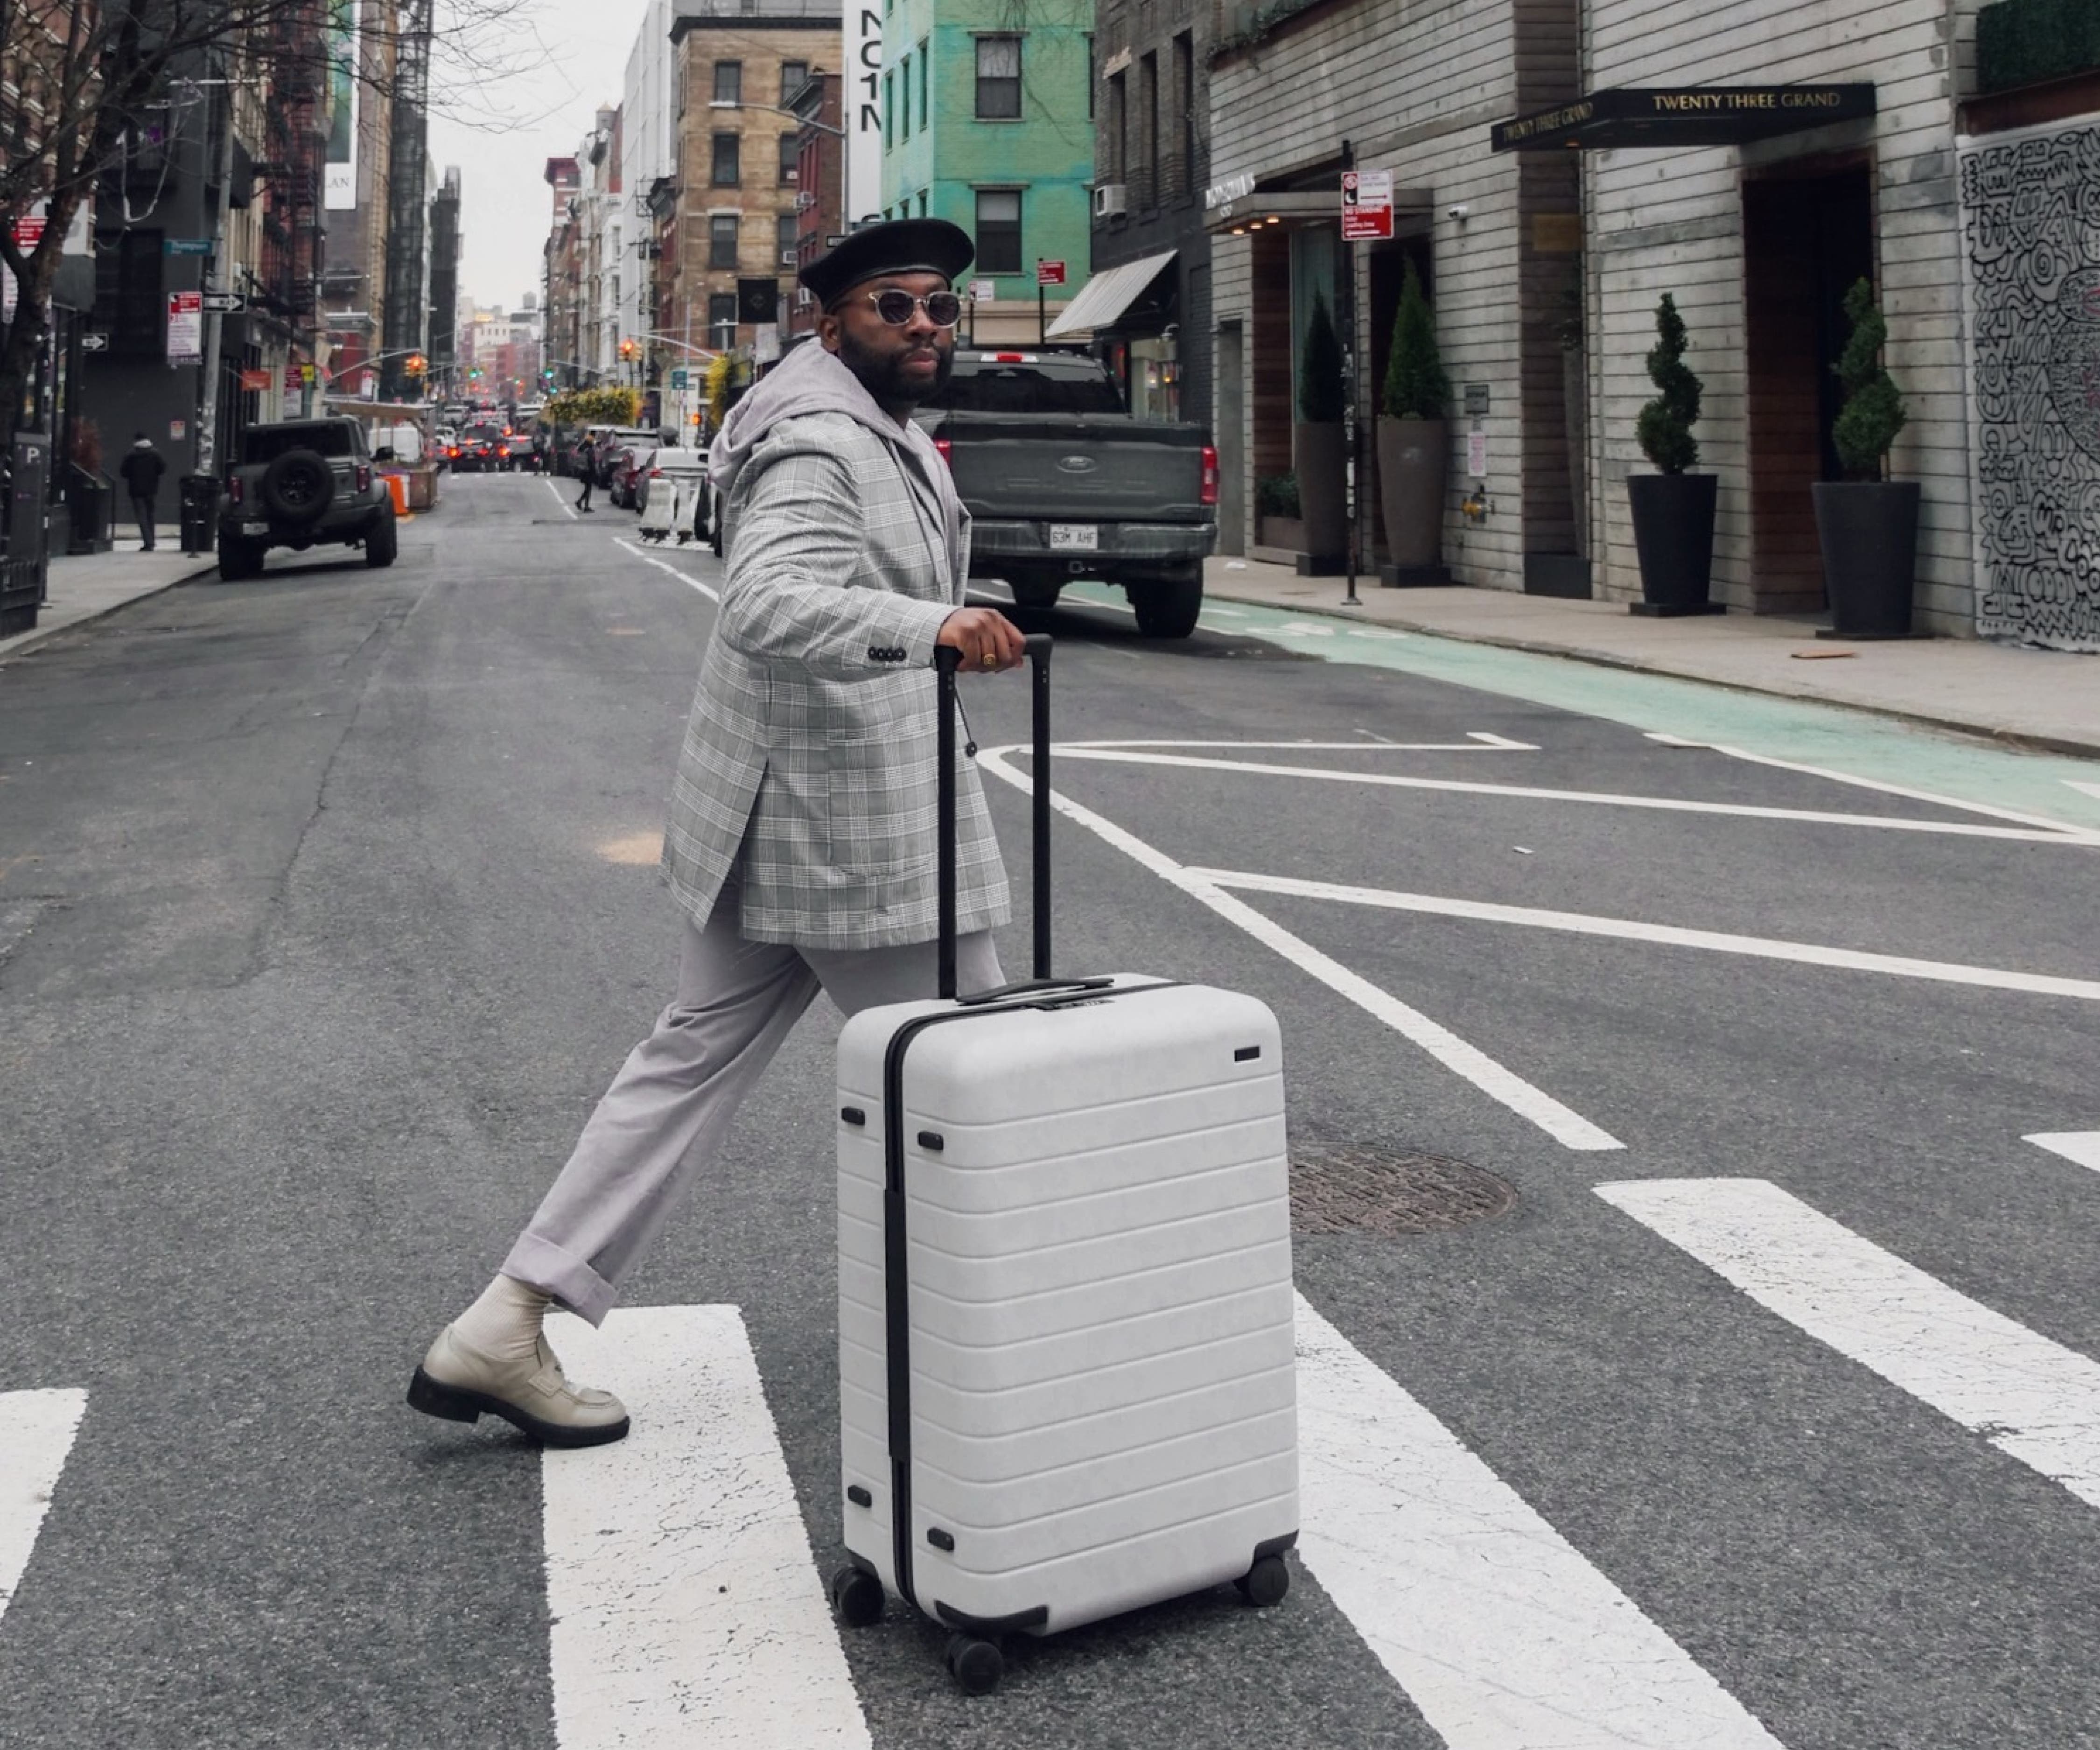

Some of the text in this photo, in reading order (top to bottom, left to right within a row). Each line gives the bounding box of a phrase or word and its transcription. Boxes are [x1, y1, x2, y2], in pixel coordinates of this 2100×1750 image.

[1652, 92, 1841, 110] TWENTY THREE GRAND
[1504, 102, 1593, 141] TWENTY THREE GRAND
[27, 447, 40, 463] P
